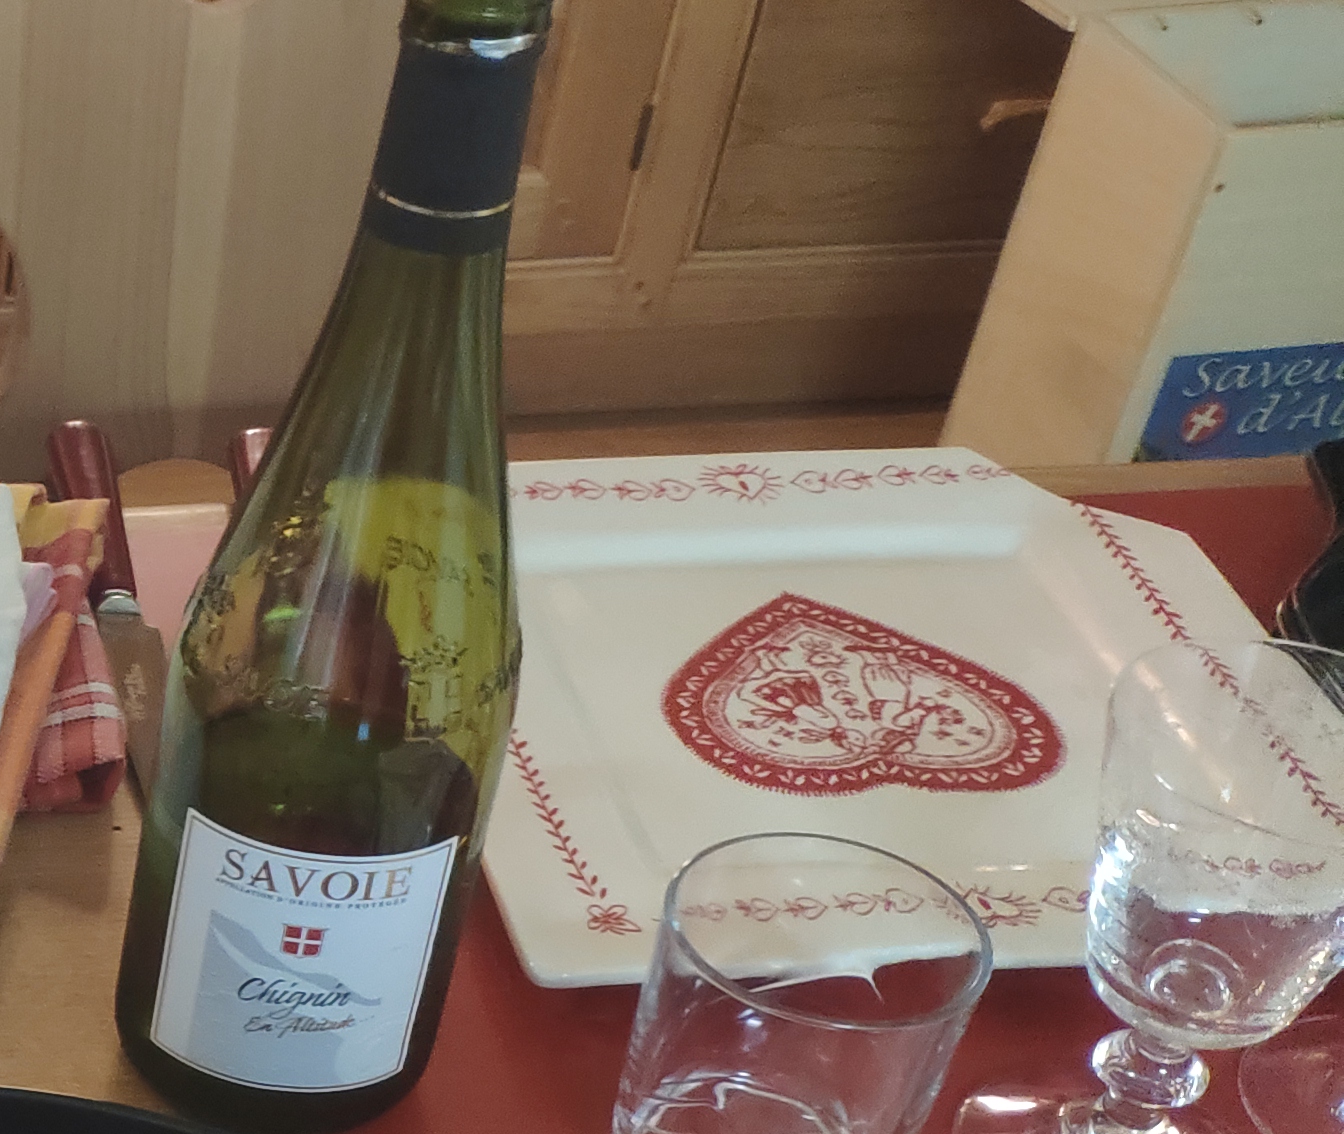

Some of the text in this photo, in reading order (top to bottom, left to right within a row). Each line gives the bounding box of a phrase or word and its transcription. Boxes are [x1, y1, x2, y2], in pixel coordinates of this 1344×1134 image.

[220, 848, 413, 901] SAVOIE
[237, 977, 352, 1020] Chignin
[243, 1015, 274, 1033] En
